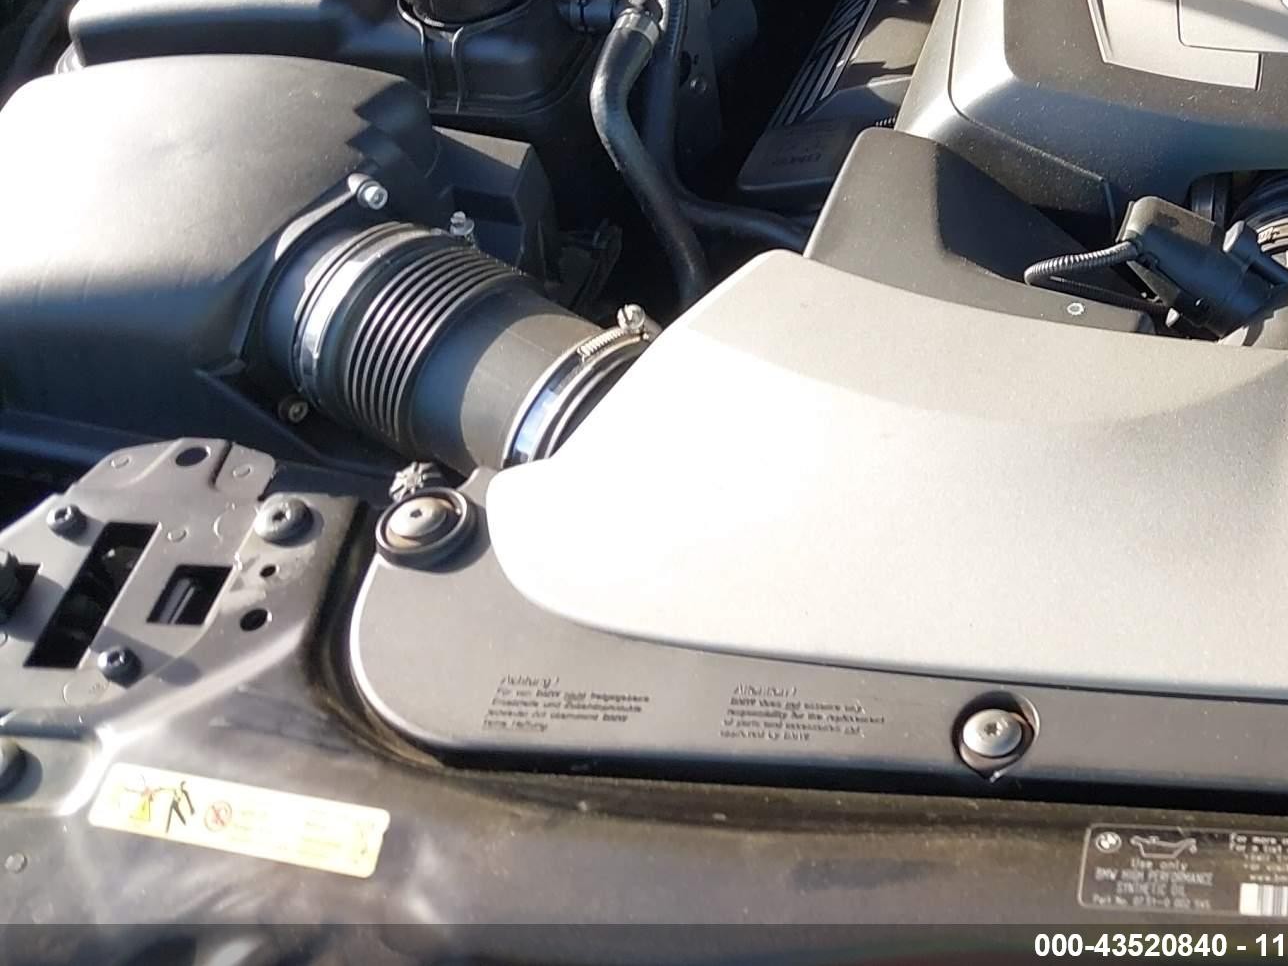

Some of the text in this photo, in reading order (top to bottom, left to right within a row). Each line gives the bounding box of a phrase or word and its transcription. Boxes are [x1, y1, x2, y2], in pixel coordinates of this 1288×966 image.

[1252, 835, 1278, 845] more
[1095, 866, 1119, 882] BMW
[1130, 857, 1189, 875] Use only
